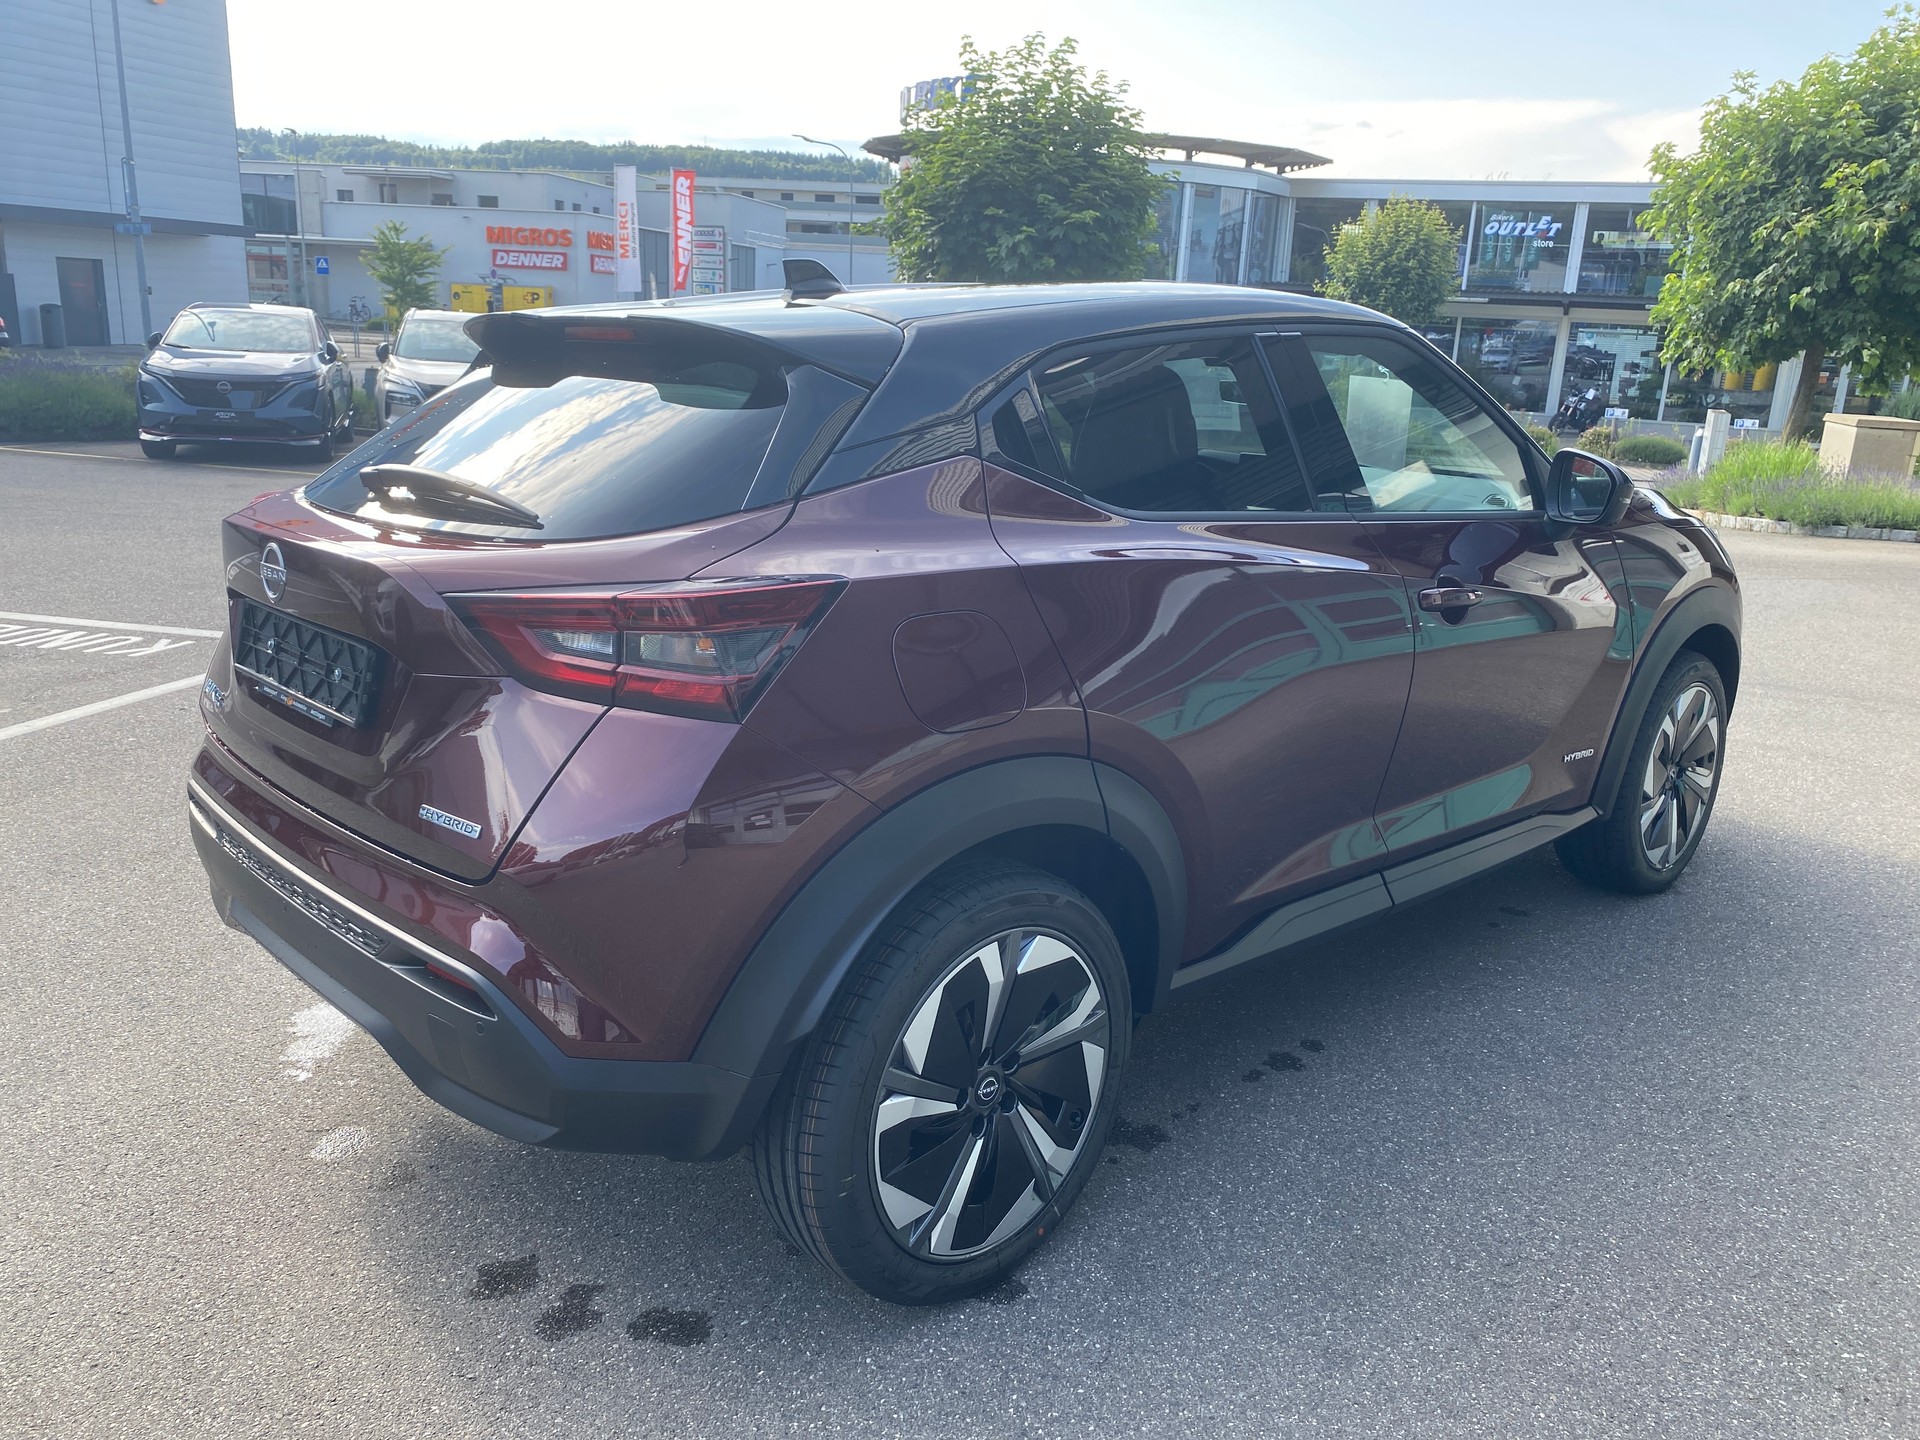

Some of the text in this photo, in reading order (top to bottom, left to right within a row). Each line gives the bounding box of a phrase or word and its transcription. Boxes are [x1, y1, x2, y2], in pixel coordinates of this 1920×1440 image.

[618, 202, 630, 259] MERCI
[1484, 215, 1562, 236] OUTLET
[486, 225, 573, 247] MIGROS
[1532, 239, 1554, 248] store
[495, 252, 564, 268] DENNER
[261, 564, 286, 582] SSAN
[1564, 748, 1594, 763] HYBRID
[424, 808, 474, 834] HYBRID
[978, 1084, 998, 1095] SSAN
